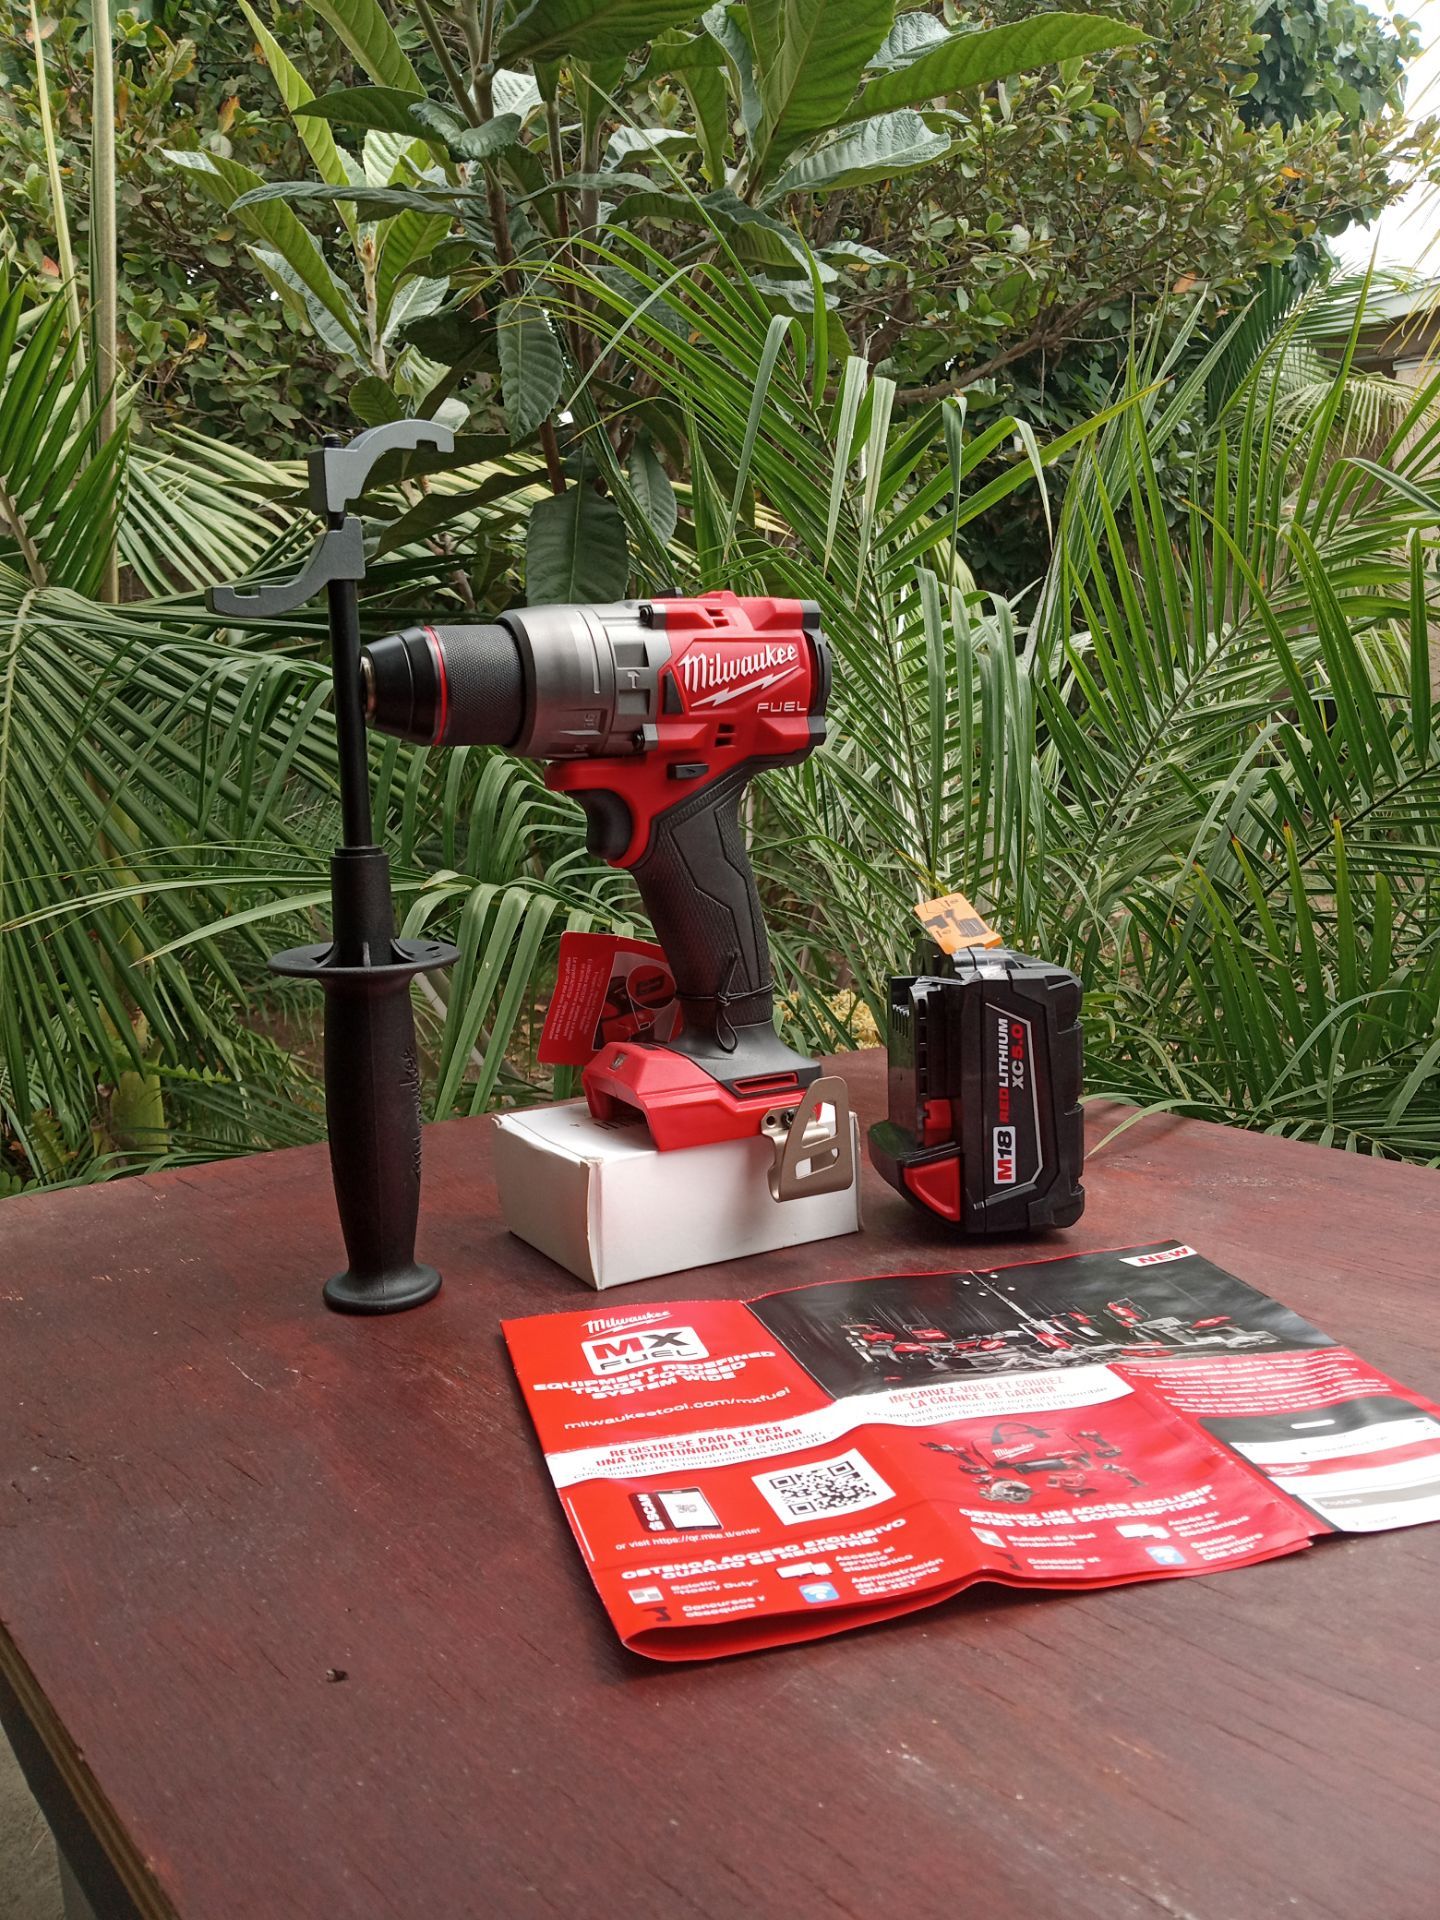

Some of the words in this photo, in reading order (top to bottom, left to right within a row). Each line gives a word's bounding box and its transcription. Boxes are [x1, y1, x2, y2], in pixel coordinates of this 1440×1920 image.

[677, 644, 798, 693] Milwaukee
[757, 701, 807, 713] FUEL
[997, 1130, 1012, 1181] M18
[1138, 1248, 1189, 1263] NEW
[581, 1310, 671, 1334] Milwaukee
[592, 1331, 689, 1360] MX
[600, 1349, 697, 1370] FUEL
[533, 1367, 656, 1391] EQUIPMENT
[662, 1351, 776, 1371] REDEFINED
[571, 1379, 641, 1395] TRADE
[647, 1362, 746, 1384] FOCUSED
[591, 1378, 677, 1399] SYSTEM
[683, 1372, 736, 1383] WIDE
[889, 1383, 994, 1404] INSCRIVEZ-VOUS
[997, 1381, 1012, 1390] ET
[1016, 1376, 1064, 1388] COUREZ
[909, 1399, 927, 1409] LA
[930, 1394, 980, 1405] CHANCE
[985, 1391, 1001, 1400] DE
[1005, 1386, 1057, 1398] GAGNER
[564, 1387, 790, 1430] milwaukeetool.com/mxfuel
[595, 1456, 626, 1467] UNA
[630, 1440, 728, 1463] OPORTUNIDAD
[733, 1438, 749, 1447] DE
[754, 1428, 803, 1443] GANAR
[610, 1439, 694, 1457] REGÍSTRESE
[699, 1433, 732, 1446] PARA
[738, 1425, 783, 1441] TENER
[959, 1508, 1039, 1521] OBTENEZ
[1041, 1509, 1069, 1518] UN
[1132, 1485, 1213, 1510] EXCLUSIF
[970, 1516, 1016, 1527] AVEC
[1016, 1517, 1076, 1527] VOTRE
[1078, 1497, 1207, 1522] SOUSCRIPTION
[621, 1559, 717, 1580] OBTENGA
[721, 1544, 800, 1564] ACCESO
[803, 1518, 907, 1548] EXCLUSIVO
[629, 1539, 650, 1548] visit
[661, 1561, 746, 1580] CUANDO
[749, 1557, 777, 1565] SE
